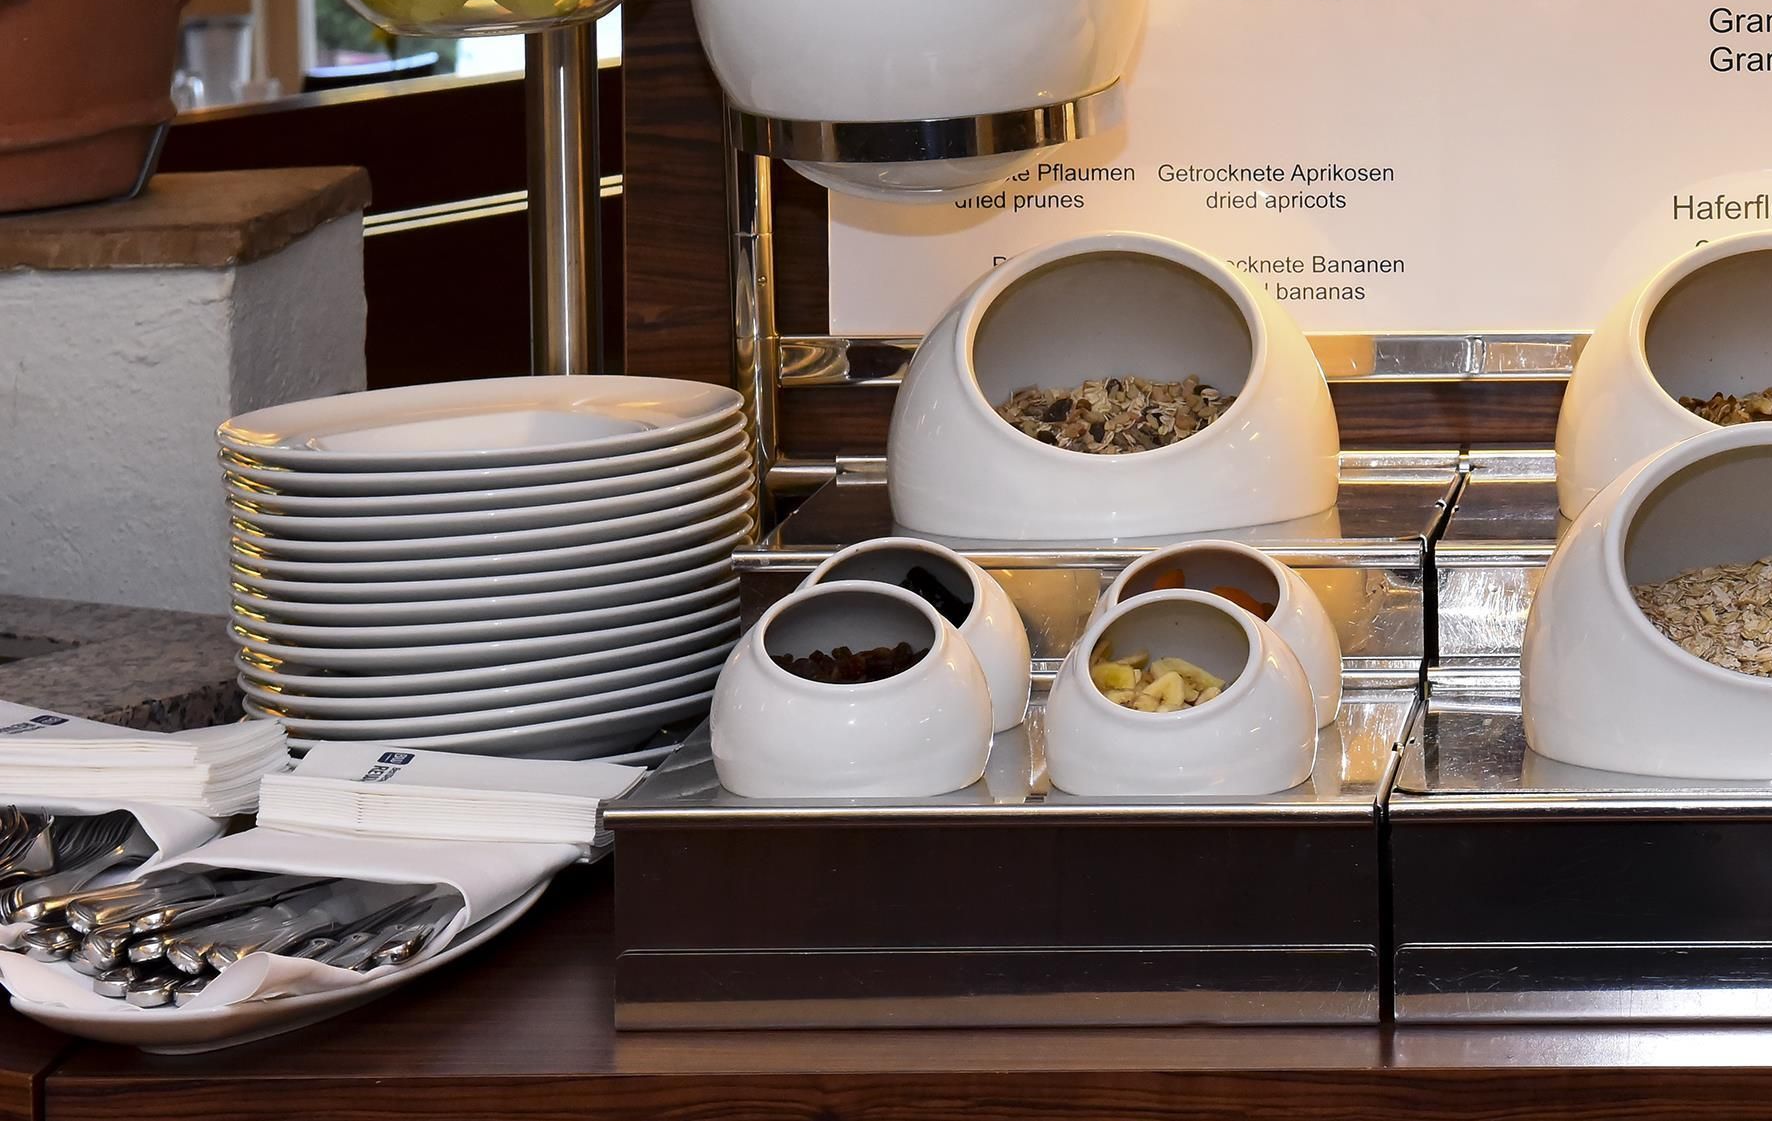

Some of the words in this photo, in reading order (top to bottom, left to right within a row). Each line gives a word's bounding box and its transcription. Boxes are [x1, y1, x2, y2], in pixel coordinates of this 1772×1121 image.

[1037, 162, 1135, 182] Pflaumen
[1157, 163, 1285, 183] Getrocknete
[1290, 163, 1394, 182] Aprikosen
[1014, 193, 1085, 213] prunes
[1206, 190, 1257, 209] dried
[1265, 190, 1347, 213] apricots
[1312, 255, 1405, 273] Bananen
[1276, 282, 1366, 300] bananas
